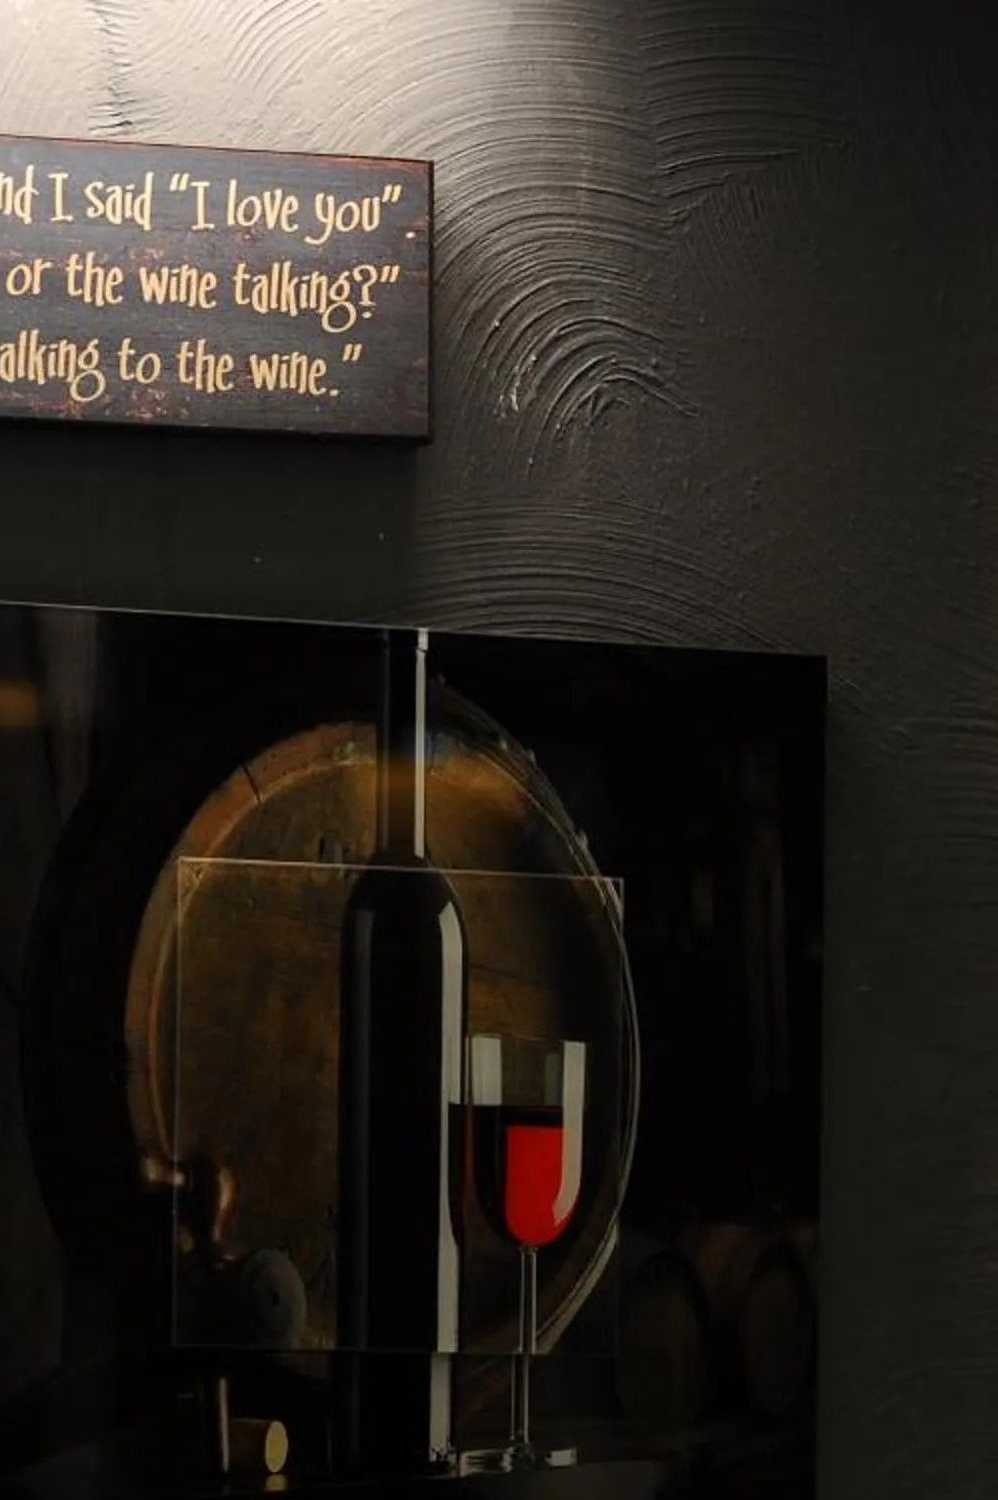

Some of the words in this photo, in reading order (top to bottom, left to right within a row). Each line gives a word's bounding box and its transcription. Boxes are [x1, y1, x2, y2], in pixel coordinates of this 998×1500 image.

[48, 172, 74, 222] I
[84, 171, 154, 231] said
[227, 179, 300, 233] love
[304, 184, 402, 246] you"
[5, 254, 53, 297] or
[65, 250, 124, 307] the
[139, 263, 218, 310] wine
[117, 337, 162, 385] to
[176, 338, 236, 394] the
